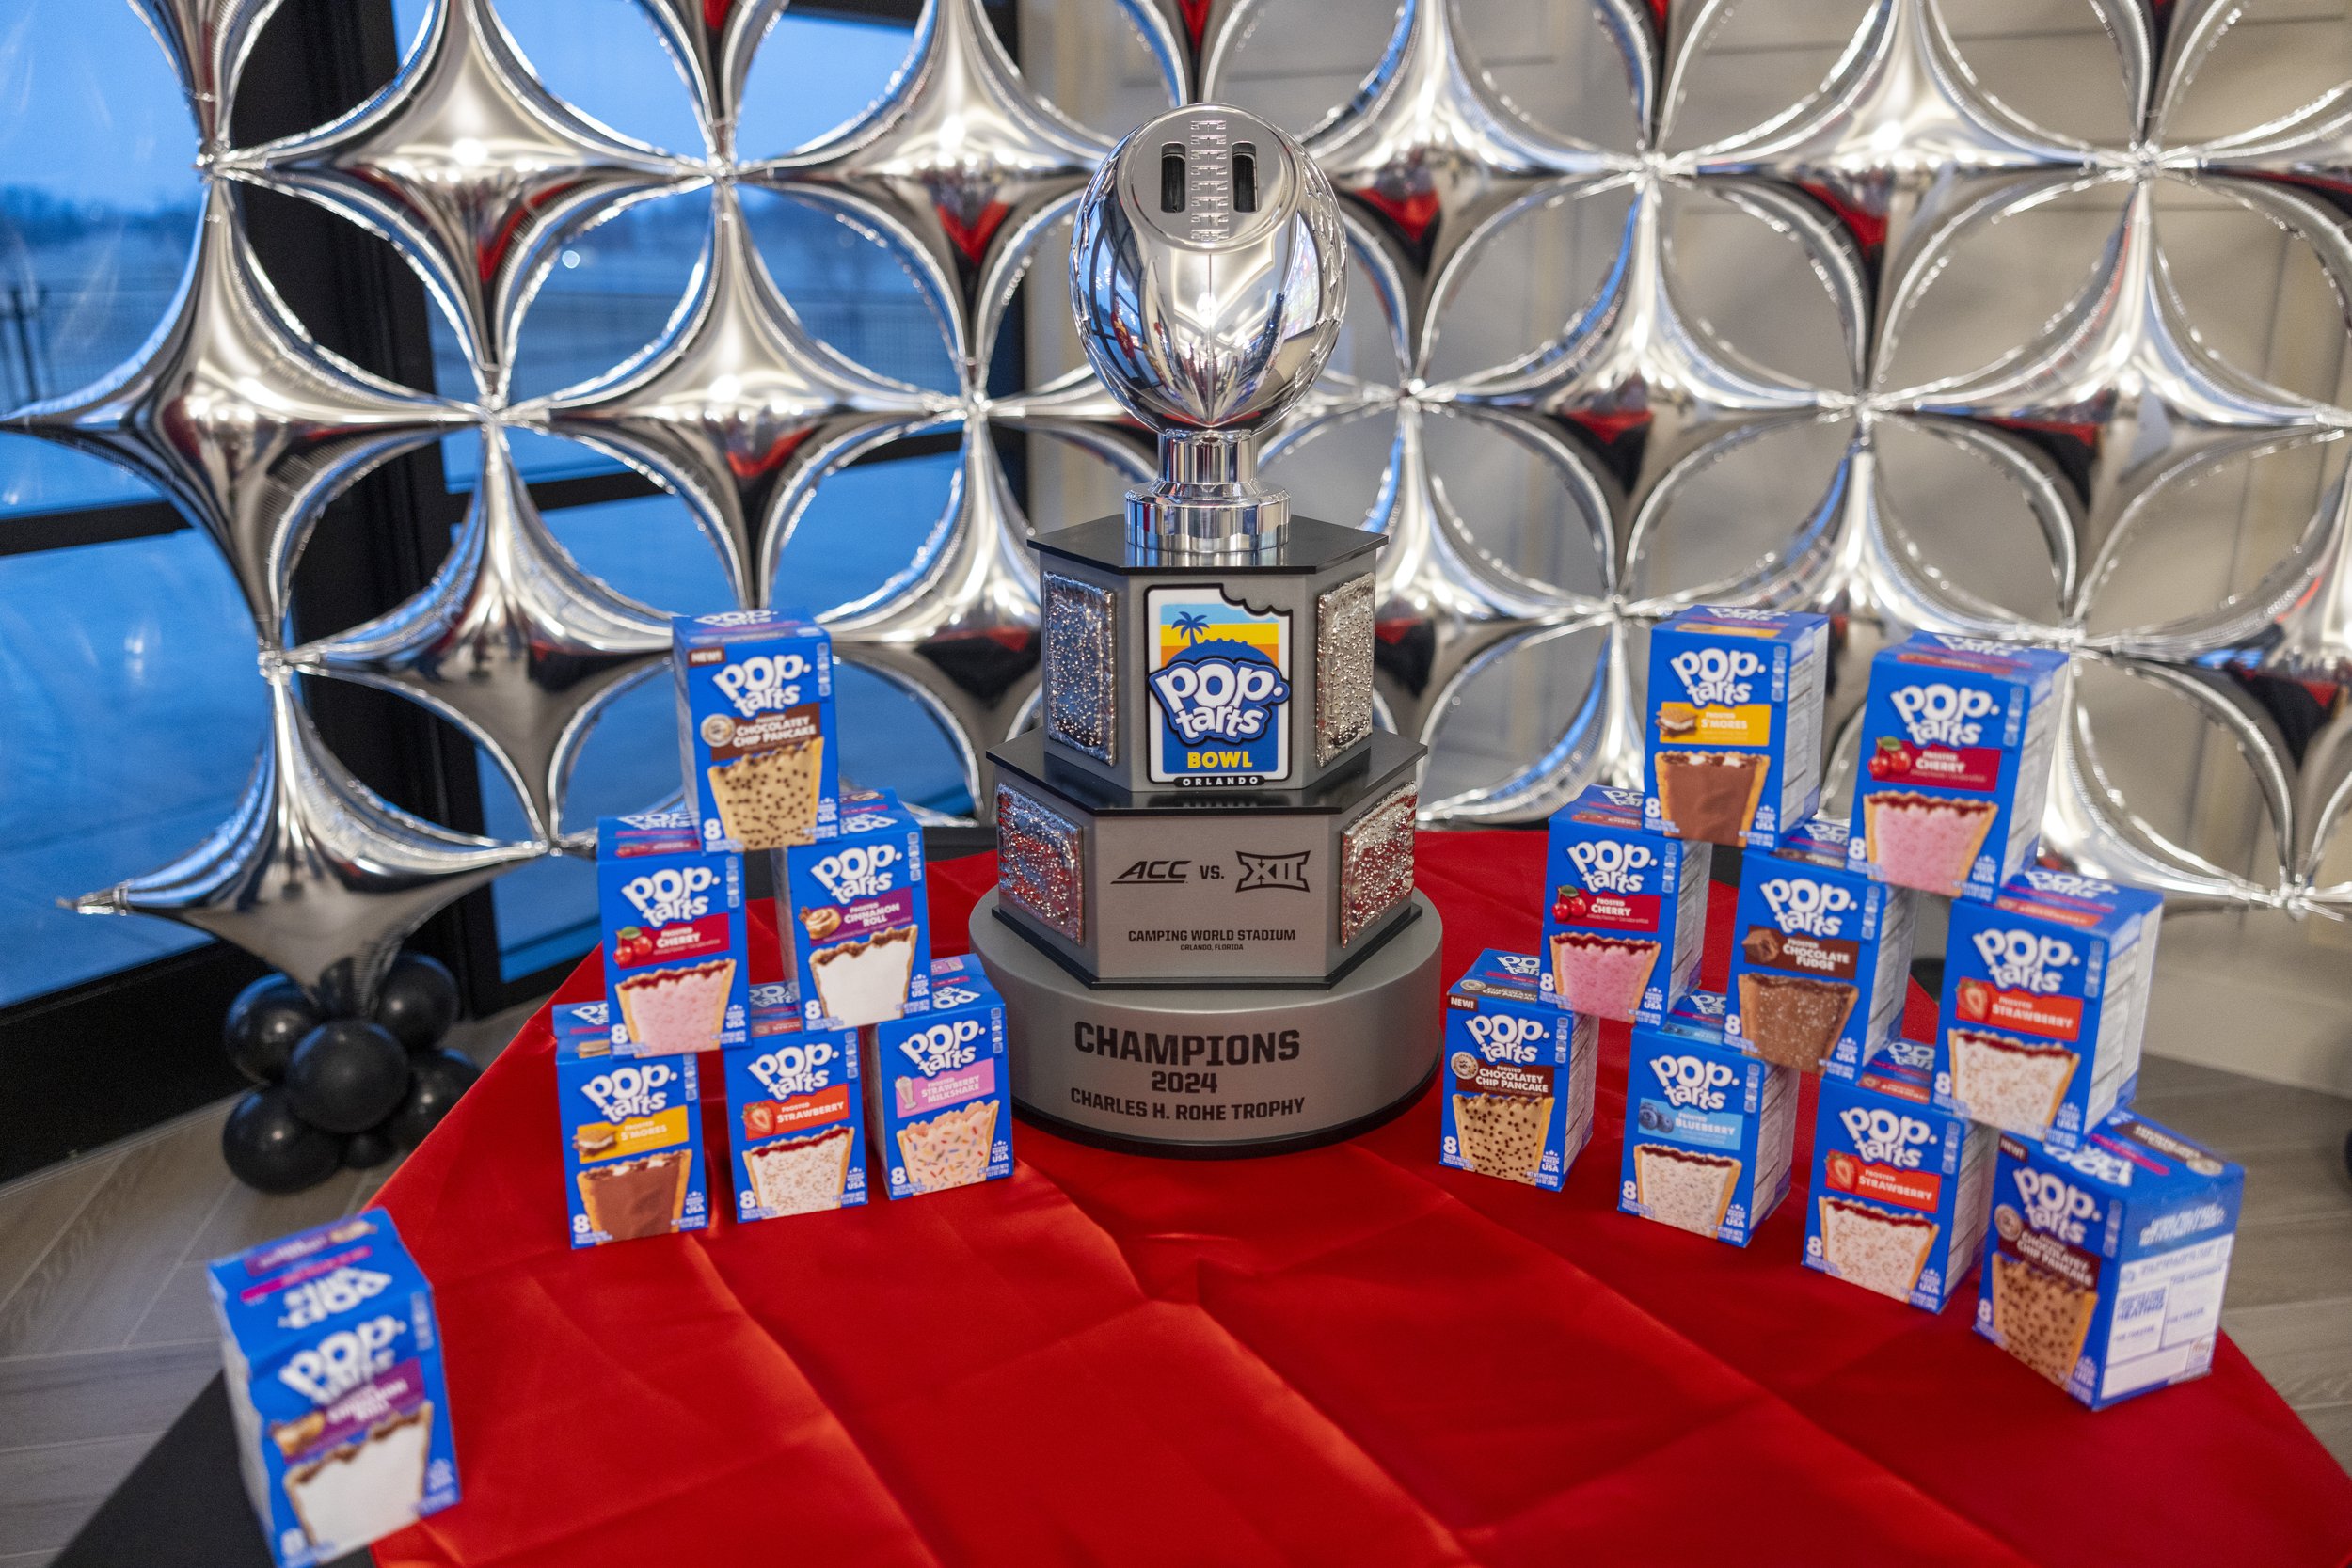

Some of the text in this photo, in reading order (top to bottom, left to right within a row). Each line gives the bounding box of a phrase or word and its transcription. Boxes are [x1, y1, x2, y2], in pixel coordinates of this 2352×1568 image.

[1175, 705, 1266, 739] tarts
[1187, 752, 1253, 768] BOWL
[1183, 775, 1259, 786] ORLANDO
[1645, 798, 1661, 817] 8
[704, 819, 722, 840] 8
[1849, 837, 1865, 859] 8
[1116, 860, 1192, 879] ACC
[1200, 865, 1225, 879] VS.
[844, 903, 900, 924] CINNAMON
[1591, 903, 1632, 917] CHERRY
[863, 916, 887, 927] ROLL
[657, 933, 701, 949] CHERRY
[1128, 929, 1295, 942] CAMPING WORLD STADIUM
[1783, 945, 1850, 964] CHOCOLATE
[1796, 957, 1835, 971] FUDGE
[1540, 973, 1555, 991] 8
[804, 1000, 822, 1020] 8
[1451, 997, 1474, 1009] NEW!
[1724, 1014, 1740, 1035] 8
[1992, 1004, 2074, 1029] STRAWBERRY
[611, 1024, 628, 1044] 8
[1074, 1021, 1300, 1066] CHAMPIONS
[1152, 1070, 1218, 1093] 2024
[1476, 1076, 1499, 1086] CHIP
[1501, 1080, 1549, 1092] PANCAKE
[1479, 1069, 1544, 1084] CHOCOLATEY
[1934, 1072, 1951, 1094] 8
[921, 1075, 980, 1098] STRAWBERRY
[928, 1083, 980, 1103] MILKSHAKE
[777, 1101, 845, 1124] STRAWBERRY
[1071, 1087, 1305, 1121] CHARLES H. ROHE TROPHY
[1676, 1117, 1736, 1136] BLUEBERRY
[1443, 1136, 1457, 1154] 8
[891, 1166, 907, 1185] 8
[1542, 1164, 1559, 1173] USA
[1622, 1180, 1637, 1200] 8
[1859, 1175, 1932, 1201] STRAWBERRY
[739, 1190, 756, 1209] 8
[573, 1214, 590, 1233] 8
[1806, 1236, 1822, 1257] 8
[1978, 1299, 1992, 1322] 8
